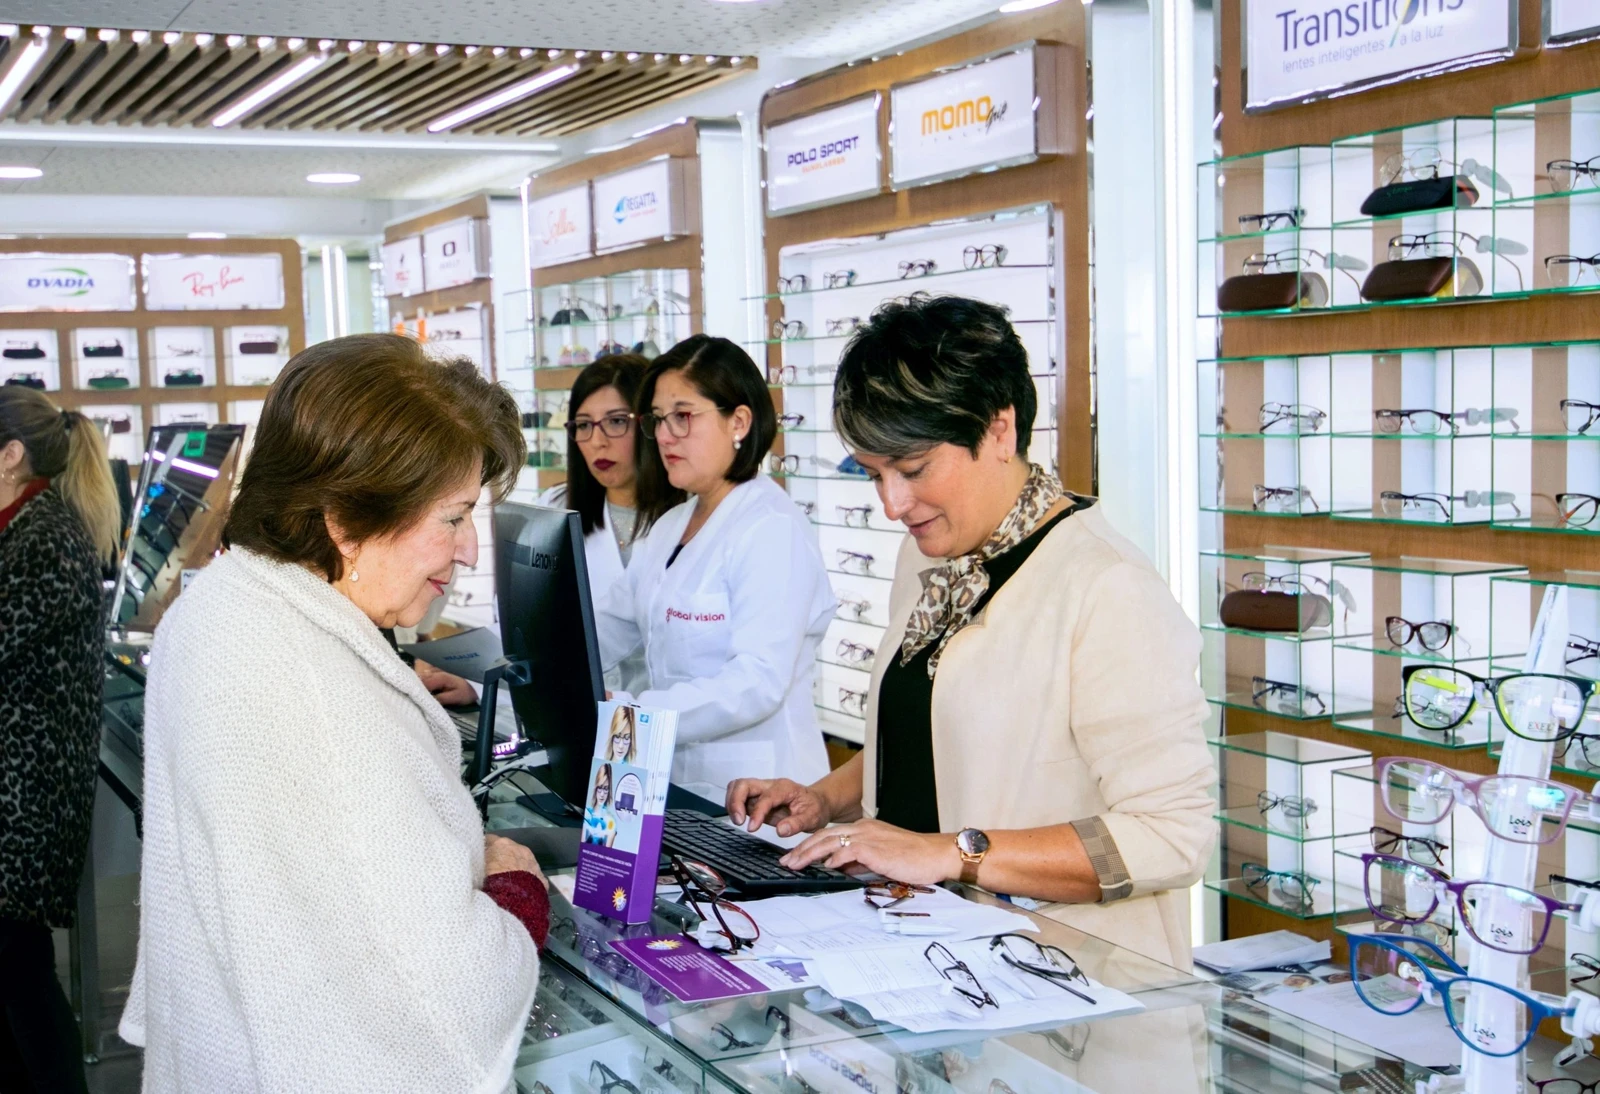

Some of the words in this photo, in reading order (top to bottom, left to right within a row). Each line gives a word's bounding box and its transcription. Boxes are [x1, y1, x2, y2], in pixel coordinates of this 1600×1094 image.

[1282, 56, 1315, 73] lentes
[1318, 39, 1385, 65] inteligentes
[1411, 29, 1422, 43] la
[1425, 25, 1444, 40] luz
[787, 147, 817, 168] POLO
[819, 135, 859, 158] SPORT
[625, 191, 658, 210] REGATTA
[666, 607, 692, 623] global
[694, 612, 725, 622] vision
[1508, 814, 1533, 828] Lois
[1490, 923, 1514, 938] Lois
[1473, 1022, 1497, 1040] Lois
